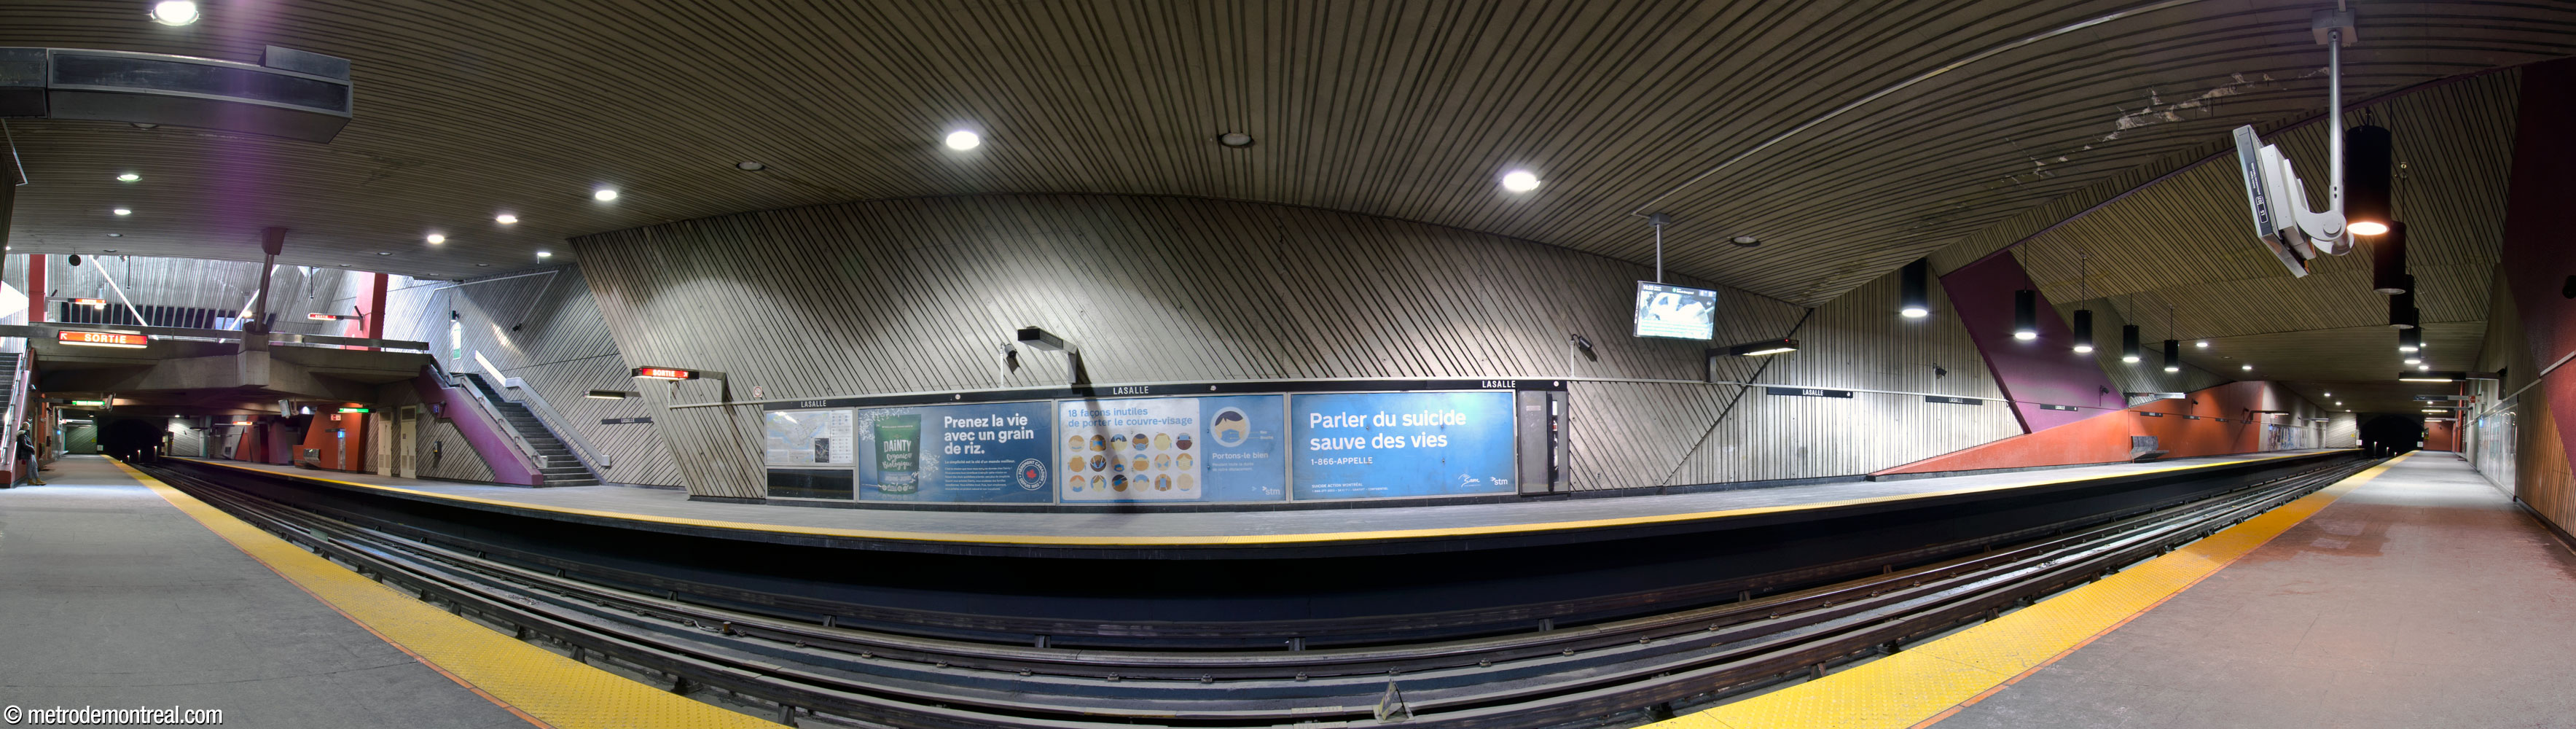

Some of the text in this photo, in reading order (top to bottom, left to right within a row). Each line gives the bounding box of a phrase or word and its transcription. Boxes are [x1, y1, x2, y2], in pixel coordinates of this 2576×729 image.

[85, 334, 126, 343] SORTIE
[1113, 386, 1149, 394] LASALLE
[1081, 409, 1111, 418] façons
[1113, 408, 1148, 416] inutiles
[944, 413, 1027, 428] Prenez la vie
[1068, 417, 1193, 429] de porter le couvre-visage
[1309, 410, 1467, 429] Parler du suicide
[944, 426, 1034, 443] avec un grain
[1309, 432, 1448, 451] sauve des vies
[944, 442, 985, 454] de riz.
[1311, 457, 1373, 466] 1-866-APPELLE
